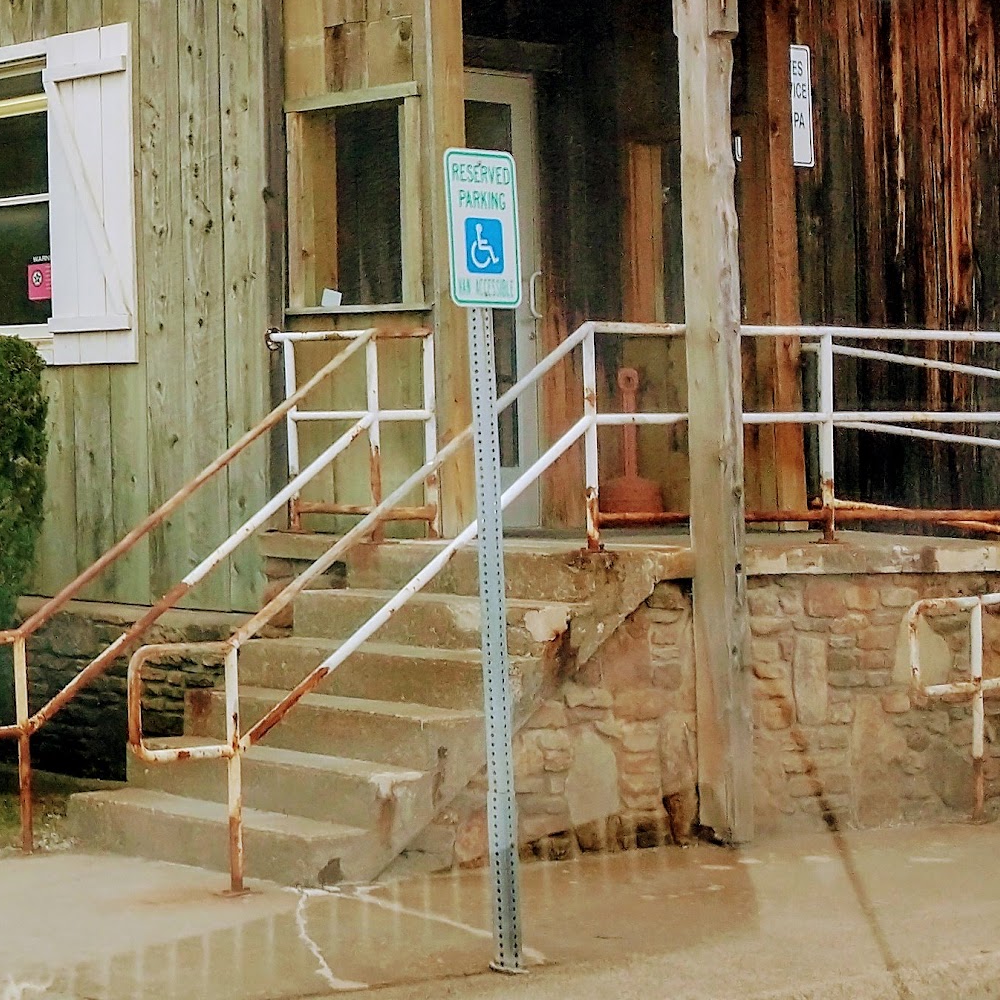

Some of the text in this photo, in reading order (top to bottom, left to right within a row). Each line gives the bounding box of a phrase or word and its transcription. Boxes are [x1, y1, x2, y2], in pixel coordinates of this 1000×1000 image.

[794, 112, 805, 129] PA
[452, 162, 511, 185] RESERVED
[459, 189, 506, 211] PARKING
